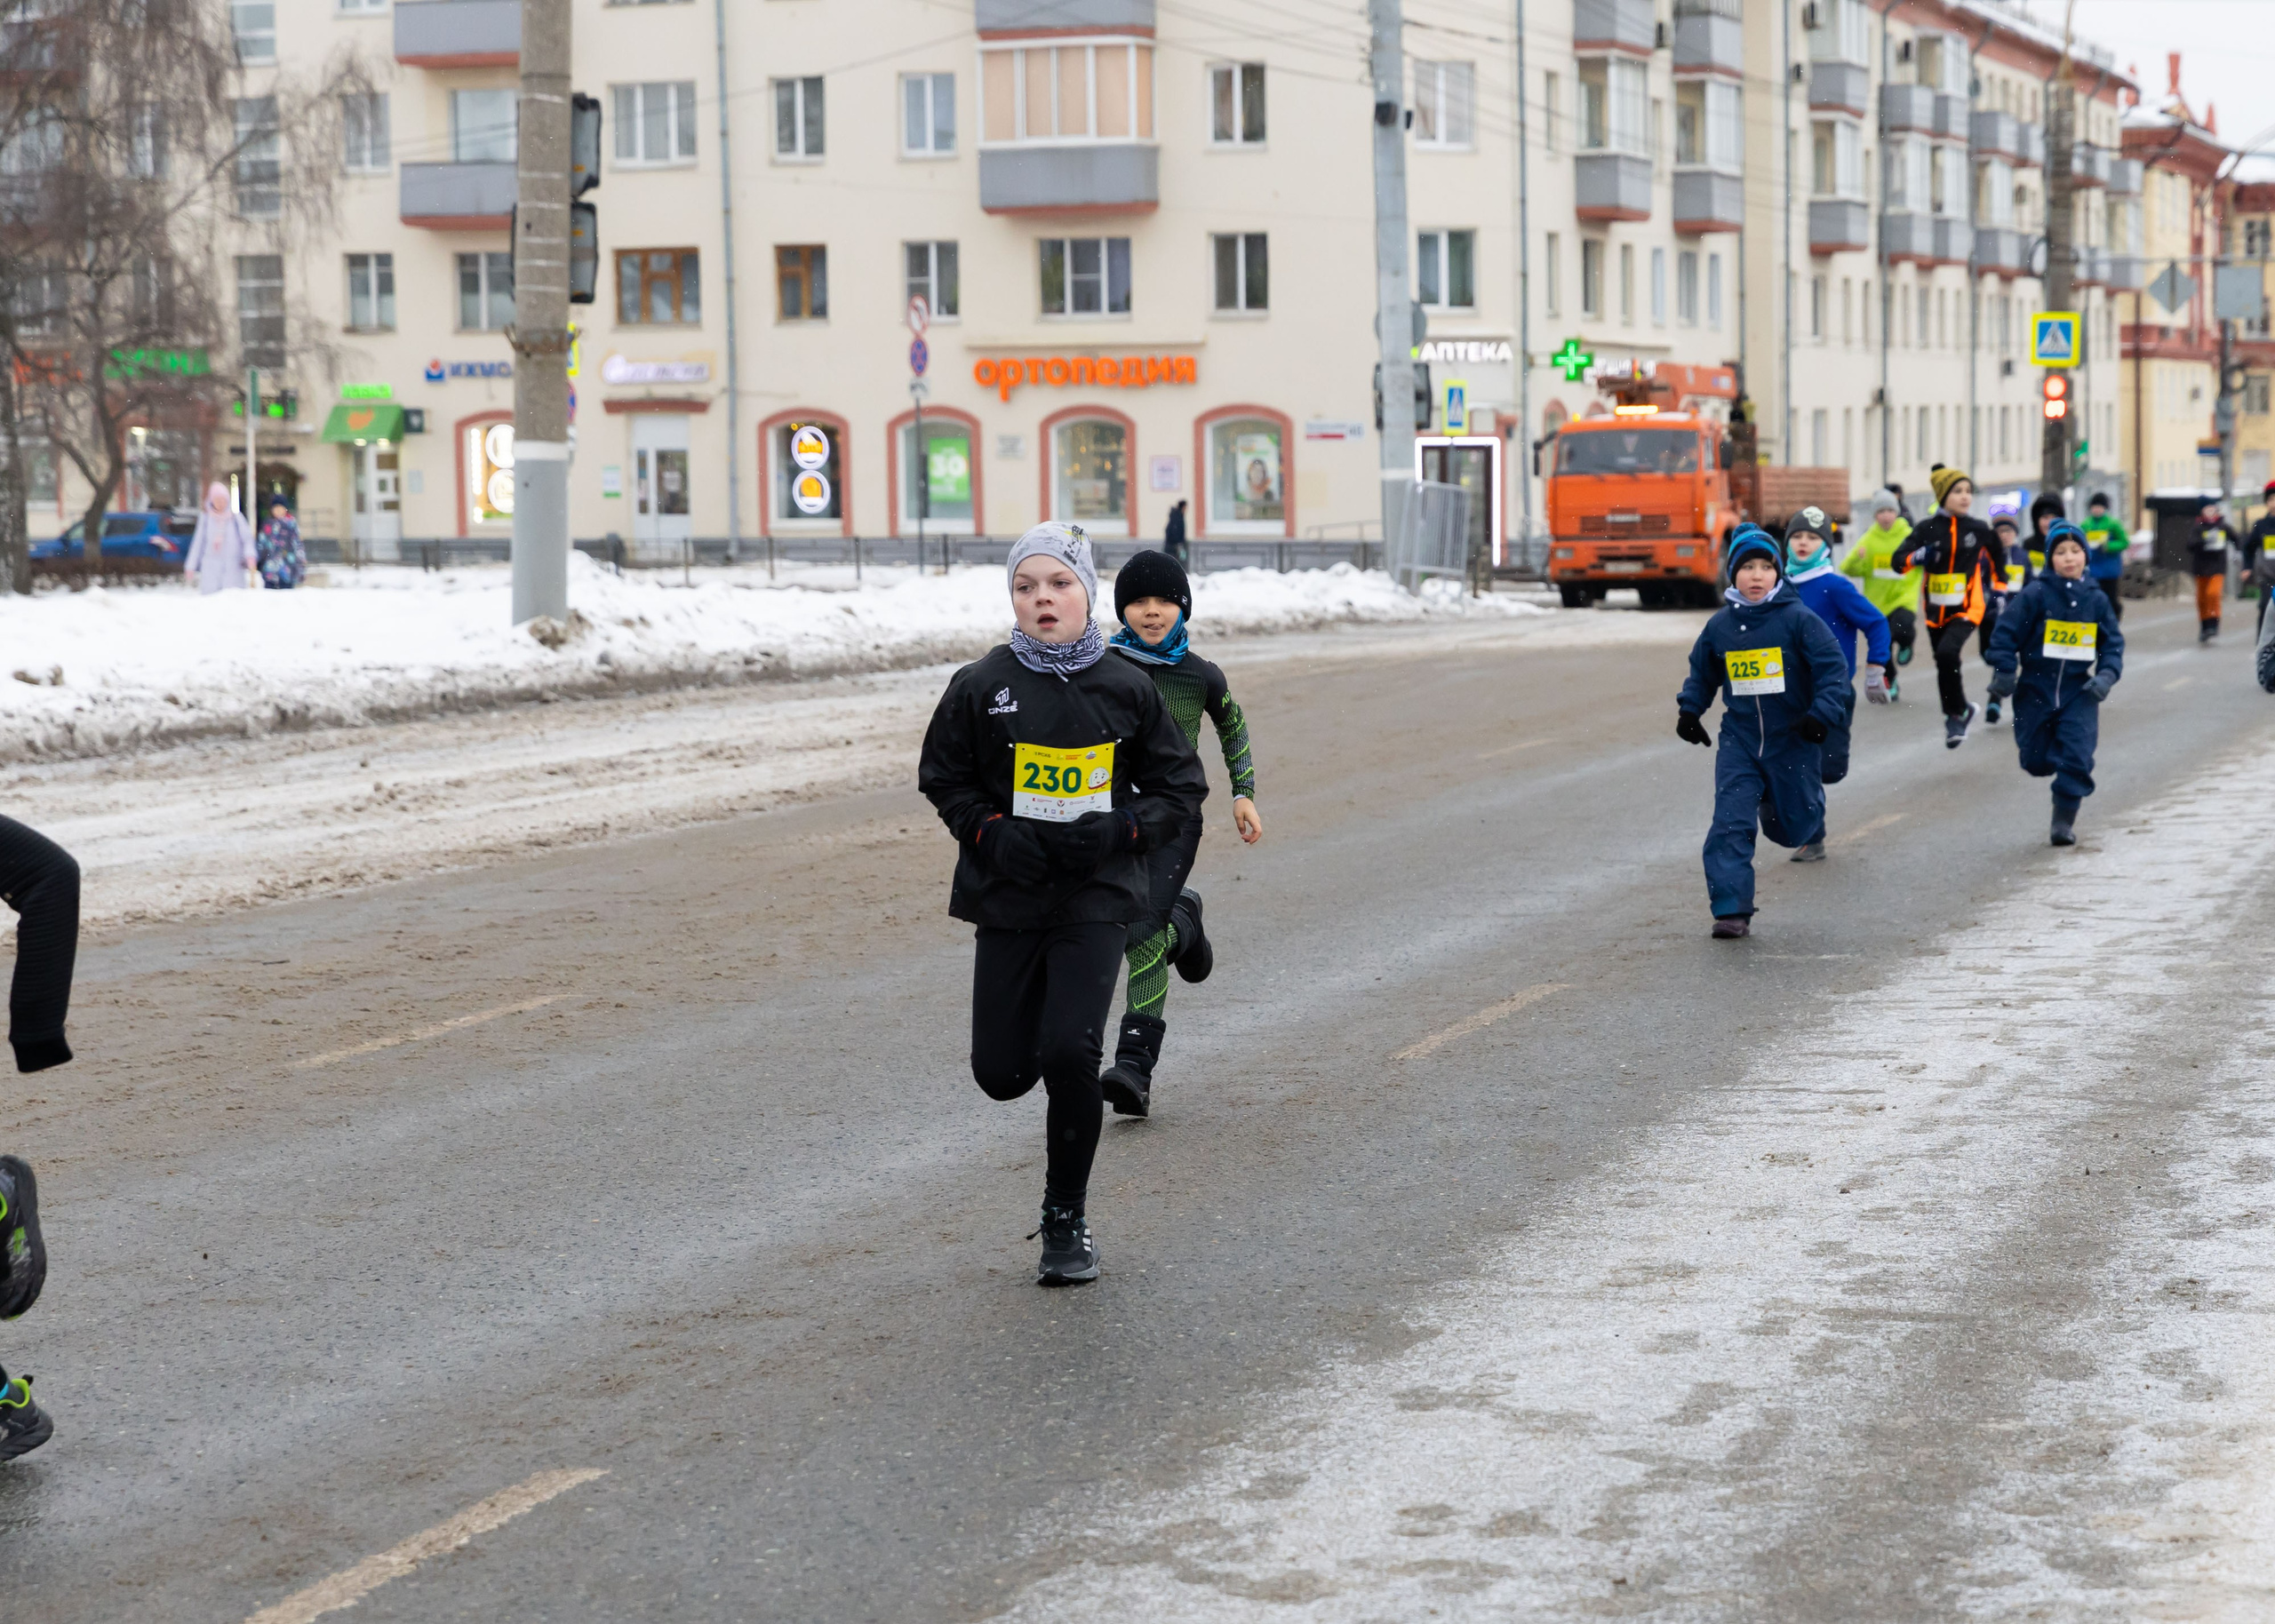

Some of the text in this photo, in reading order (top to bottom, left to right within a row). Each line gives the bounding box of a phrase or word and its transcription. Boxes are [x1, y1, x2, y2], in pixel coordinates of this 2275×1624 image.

[1420, 341, 1513, 362] АПТЕКА
[974, 355, 1196, 402] ортопедия
[2050, 629, 2078, 645] 226
[1731, 661, 1760, 678] 225
[987, 705, 1018, 715] ONZE
[1022, 761, 1082, 793] 230
